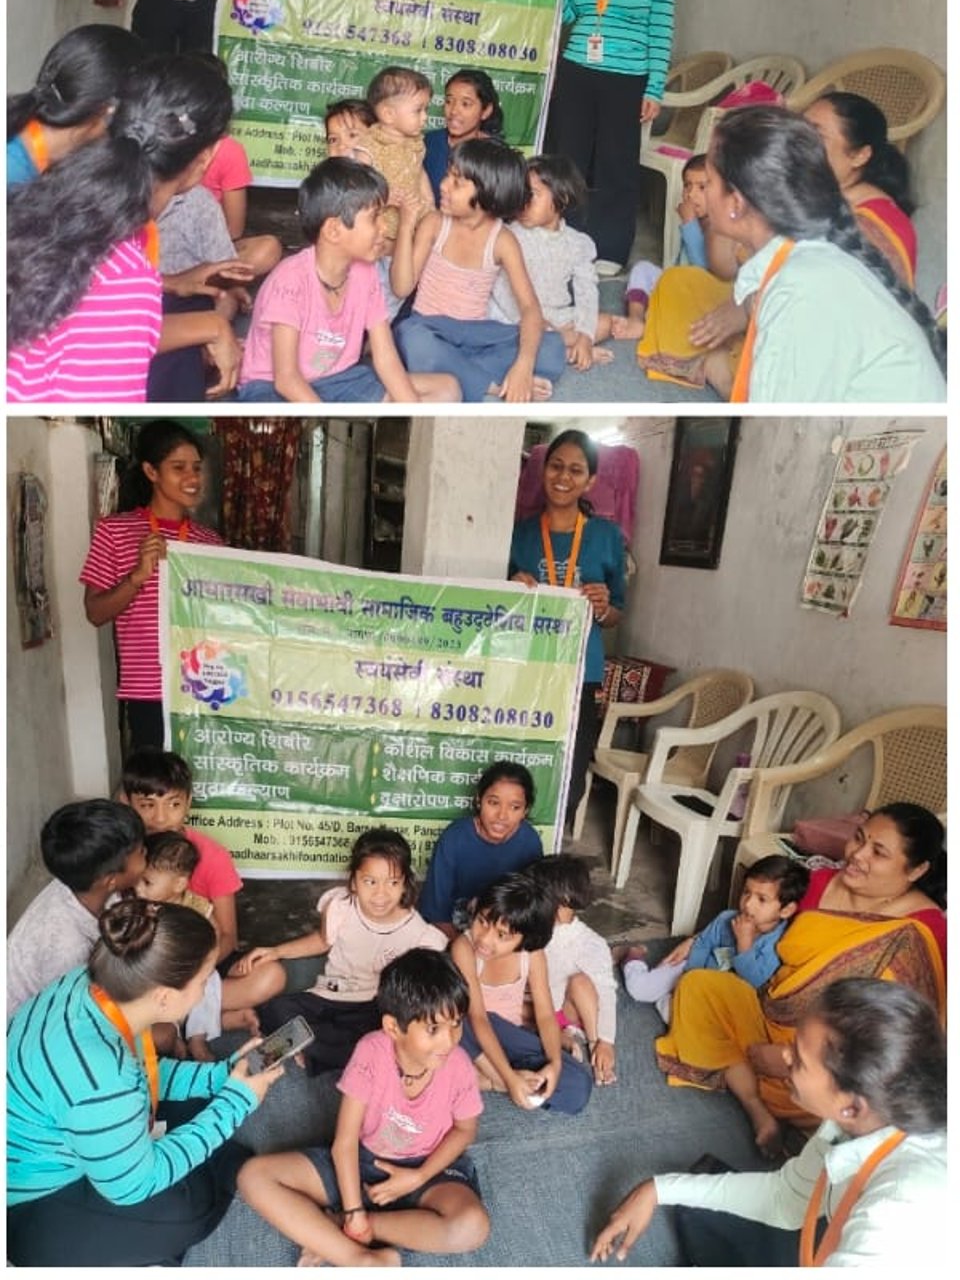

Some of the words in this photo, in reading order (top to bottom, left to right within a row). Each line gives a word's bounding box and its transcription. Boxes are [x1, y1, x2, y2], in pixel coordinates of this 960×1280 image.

[441, 2, 480, 26] संस्था
[361, 596, 435, 622] सामाजिक
[194, 725, 256, 748] आरोग्य
[439, 742, 490, 763] विकास
[193, 752, 279, 776] सांस्कृतिक
[284, 758, 351, 780] कार्यक्रम
